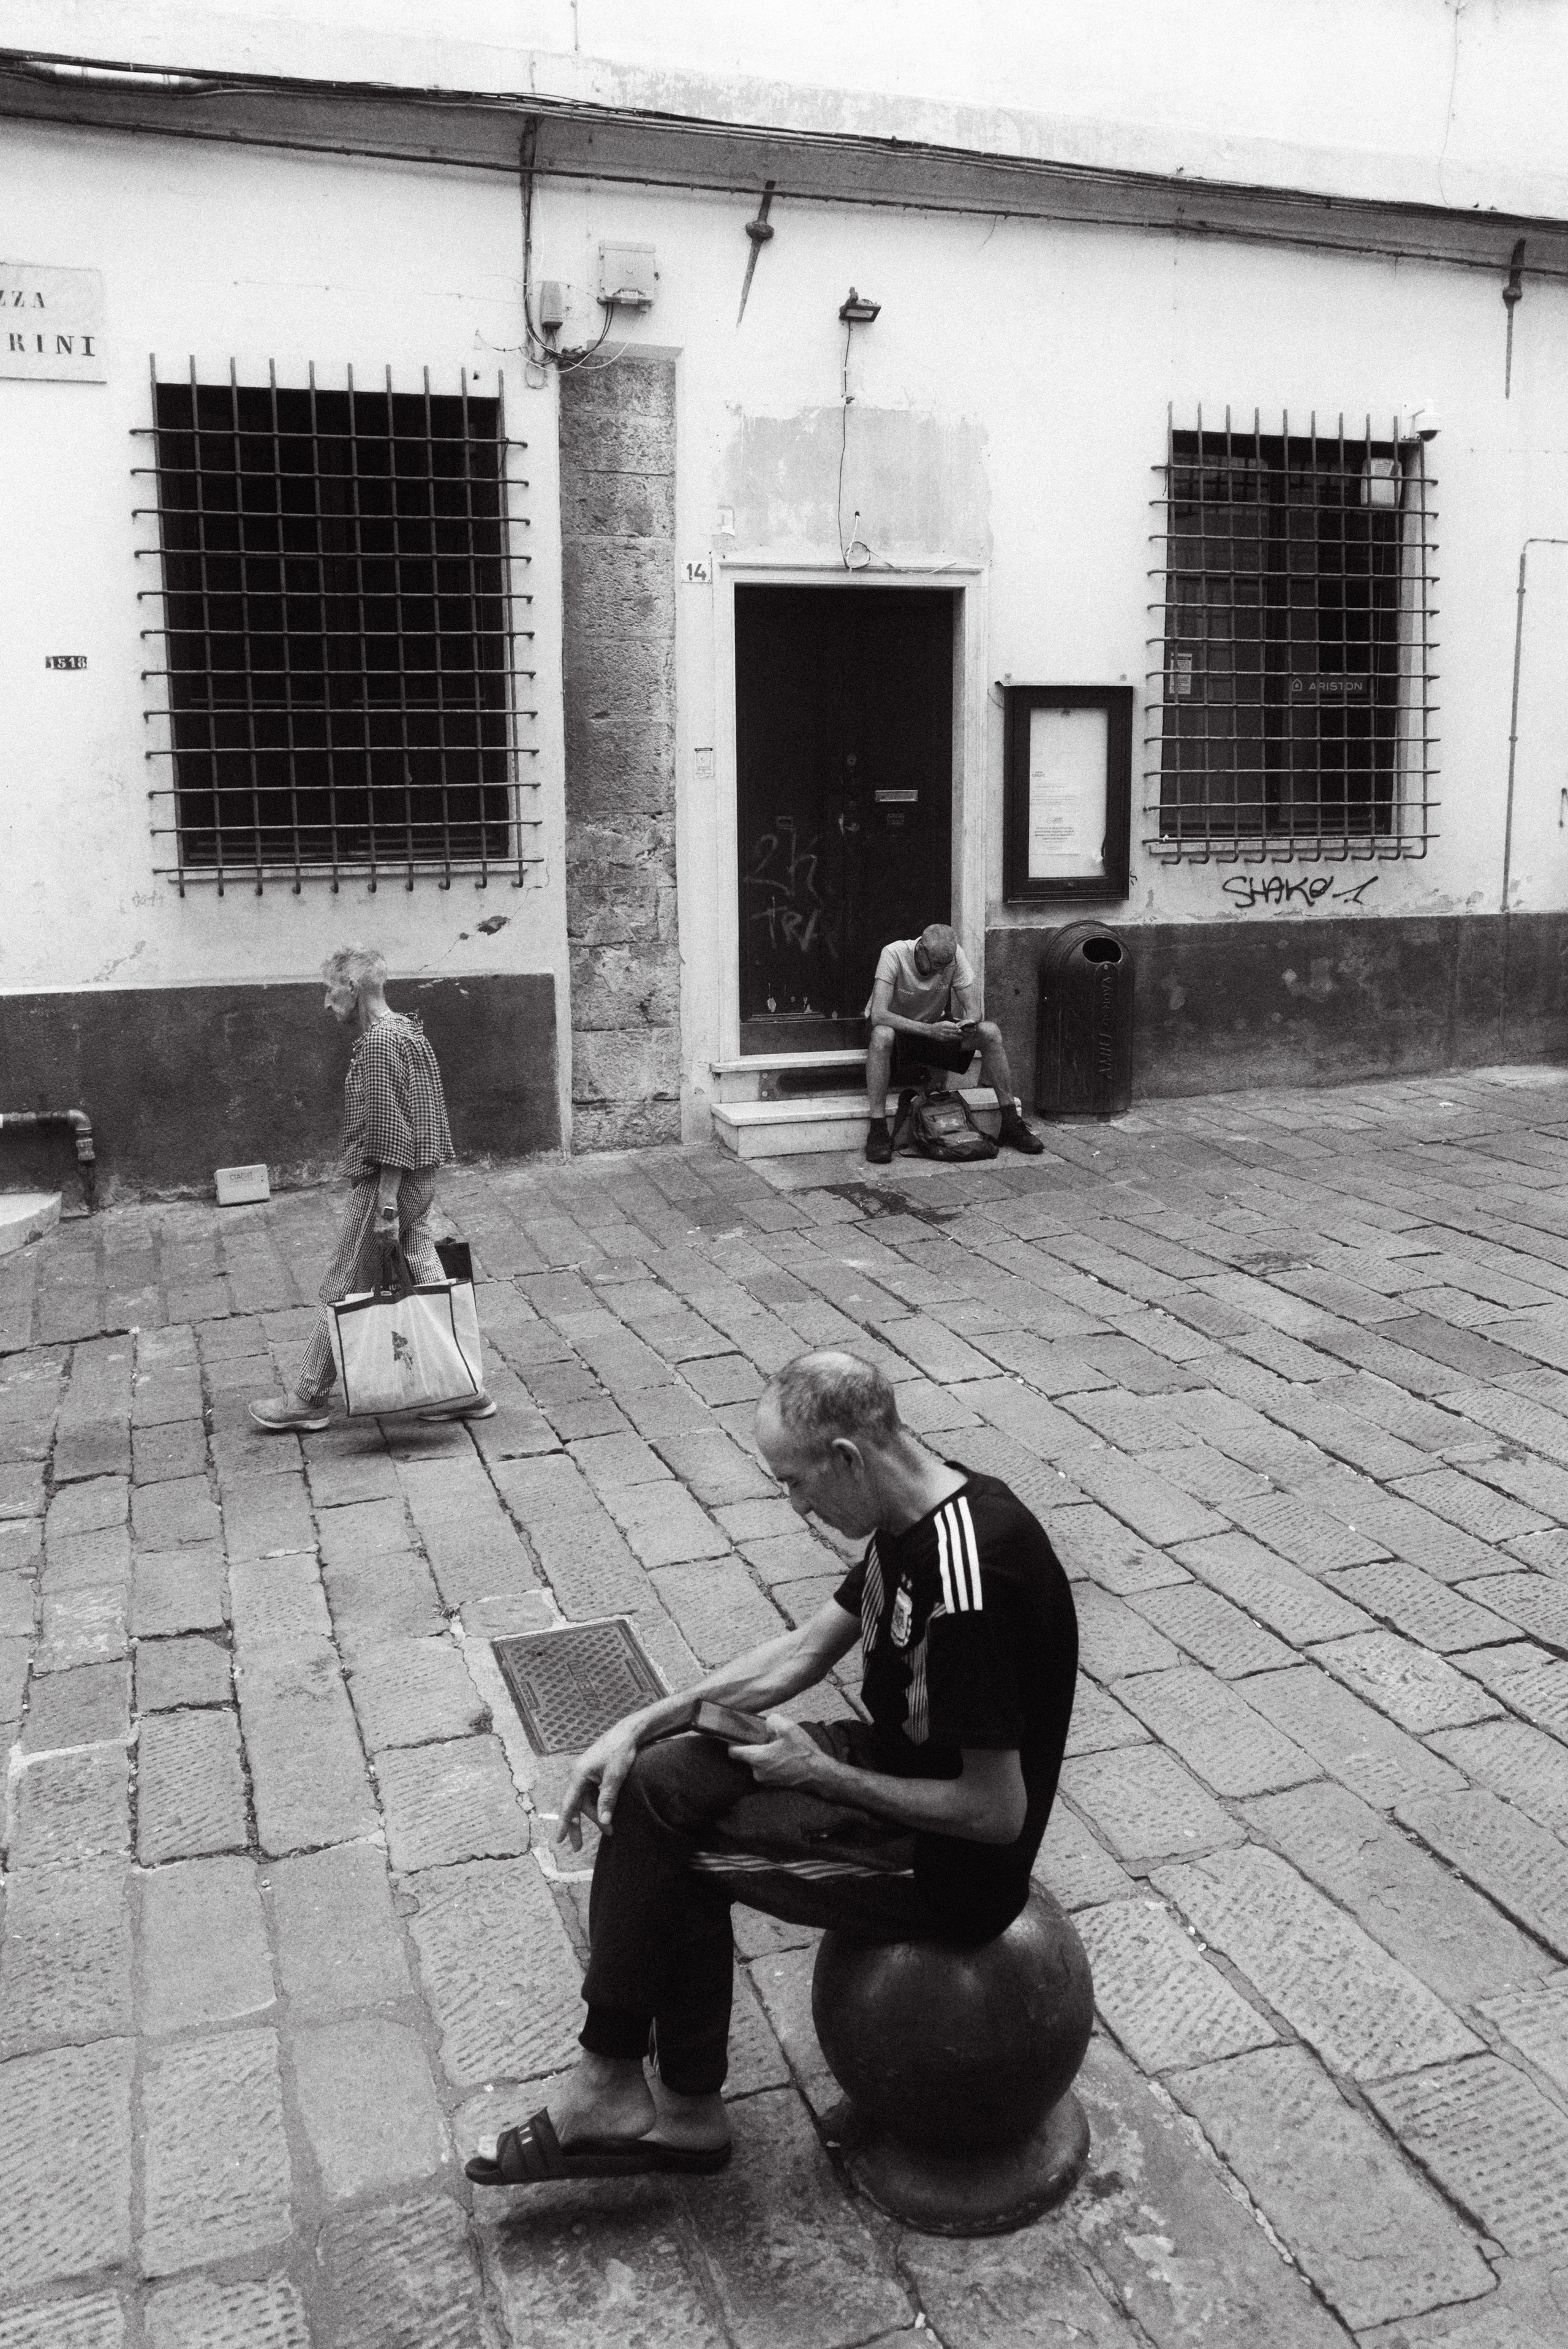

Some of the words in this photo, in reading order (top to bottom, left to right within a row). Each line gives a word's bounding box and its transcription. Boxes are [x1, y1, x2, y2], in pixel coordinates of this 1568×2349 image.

[8, 332, 95, 357] RINI
[687, 563, 707, 581] 14
[48, 656, 86, 668] 1518
[1308, 681, 1363, 691] ARISTON
